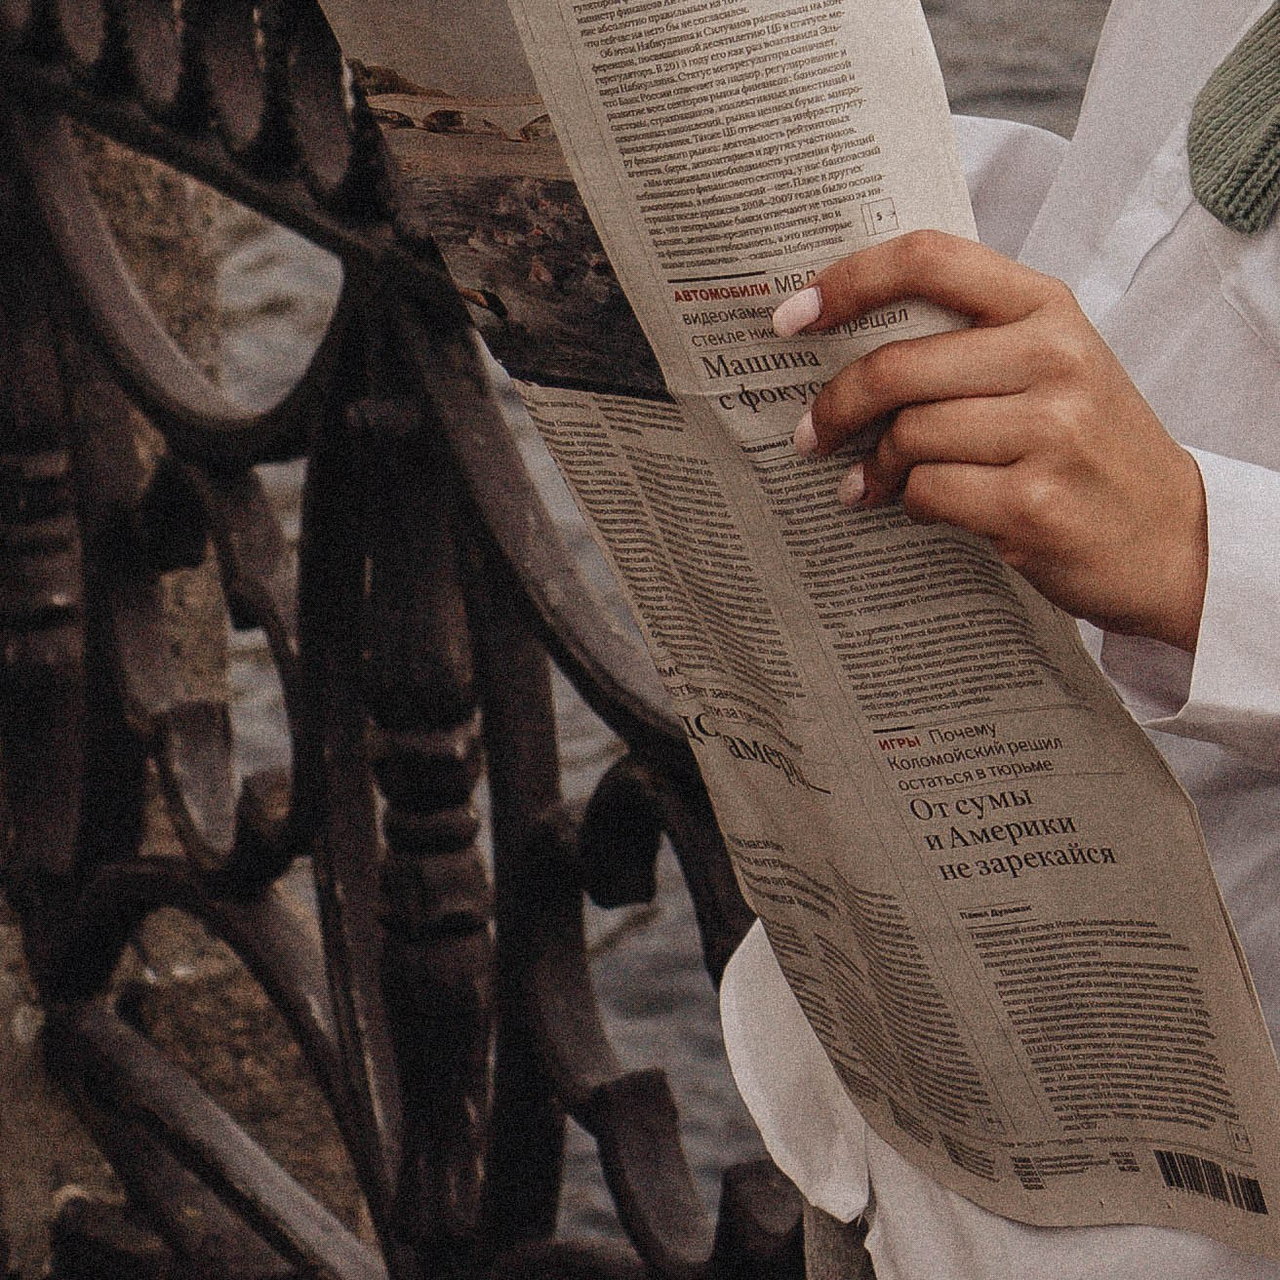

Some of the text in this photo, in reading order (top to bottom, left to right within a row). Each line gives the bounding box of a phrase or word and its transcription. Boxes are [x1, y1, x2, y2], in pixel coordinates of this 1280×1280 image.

[674, 282, 771, 303] АВТОМОБИЛИ
[691, 329, 747, 348] стекле
[701, 348, 822, 380] Машина
[718, 378, 829, 414] с фокус
[879, 722, 998, 751] ИГРЫ Почему
[887, 735, 1063, 772] Коломойский решил
[898, 757, 1055, 791] остаться в тюрьме
[909, 787, 1035, 822] От сумы
[925, 814, 1078, 852] и Америки
[938, 840, 1118, 881] не зарекайся
